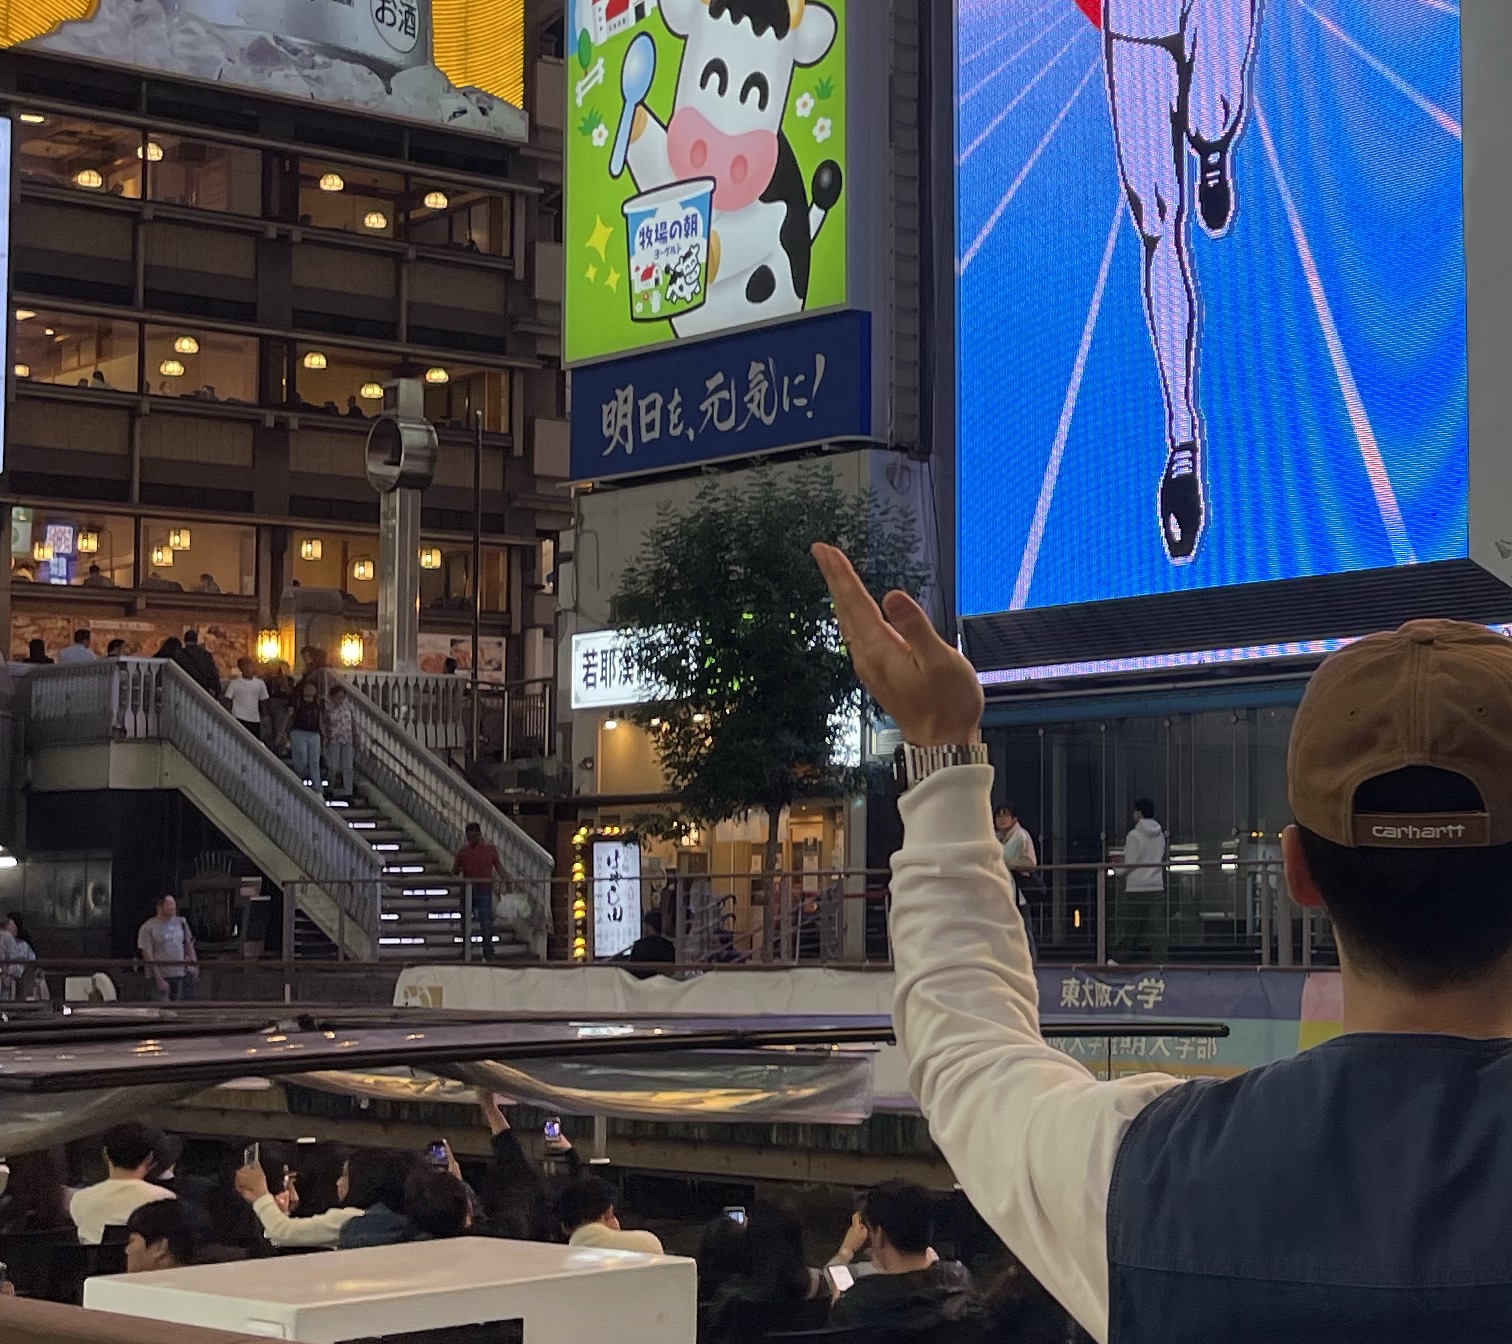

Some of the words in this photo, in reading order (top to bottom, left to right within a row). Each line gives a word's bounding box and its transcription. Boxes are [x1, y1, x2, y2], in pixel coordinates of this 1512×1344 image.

[638, 212, 699, 251] 牧場の朝
[1371, 824, 1466, 839] carhartt
